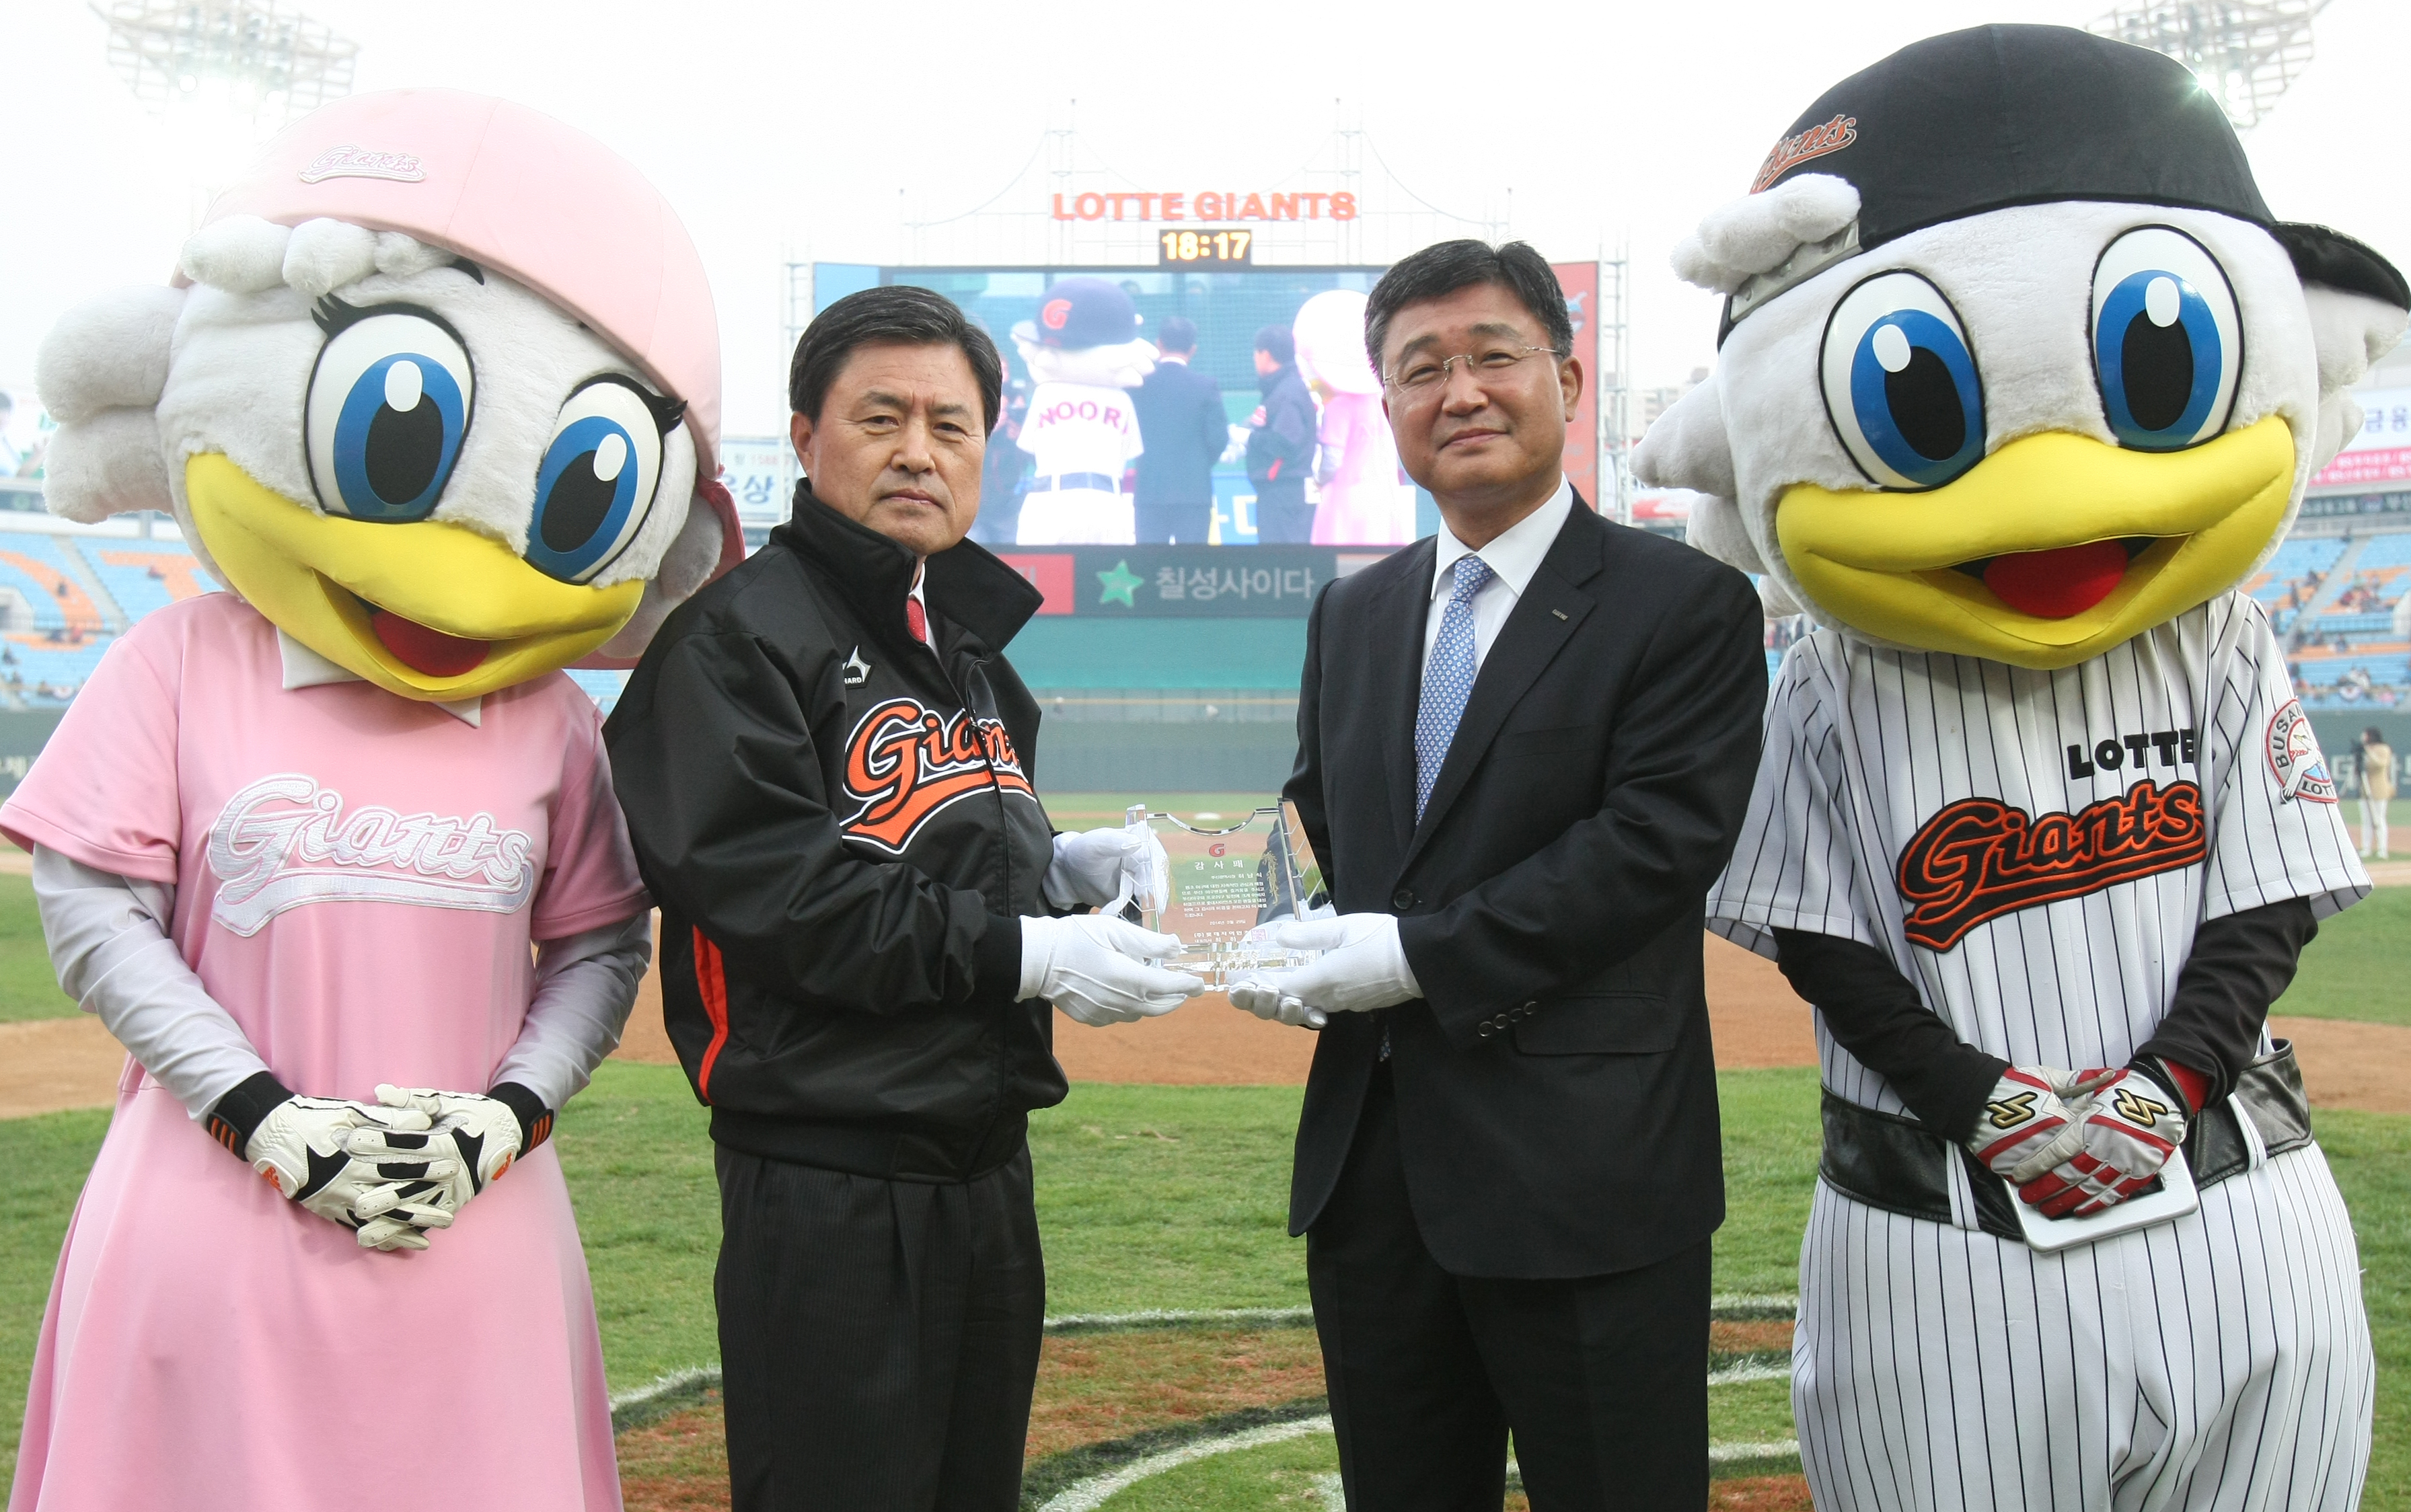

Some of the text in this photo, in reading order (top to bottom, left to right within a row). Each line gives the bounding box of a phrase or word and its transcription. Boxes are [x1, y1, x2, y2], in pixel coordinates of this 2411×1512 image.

[300, 144, 426, 182] Giants
[1051, 191, 1357, 221] LOTTE GIANTS
[1162, 232, 1251, 260] 18:17
[1043, 299, 1072, 330] G
[1156, 567, 1314, 599] 칠성사이다
[2067, 728, 2194, 780] LOTTE
[209, 773, 535, 918] Giants
[1209, 843, 1225, 857] G
[1896, 780, 2205, 938] Giants
